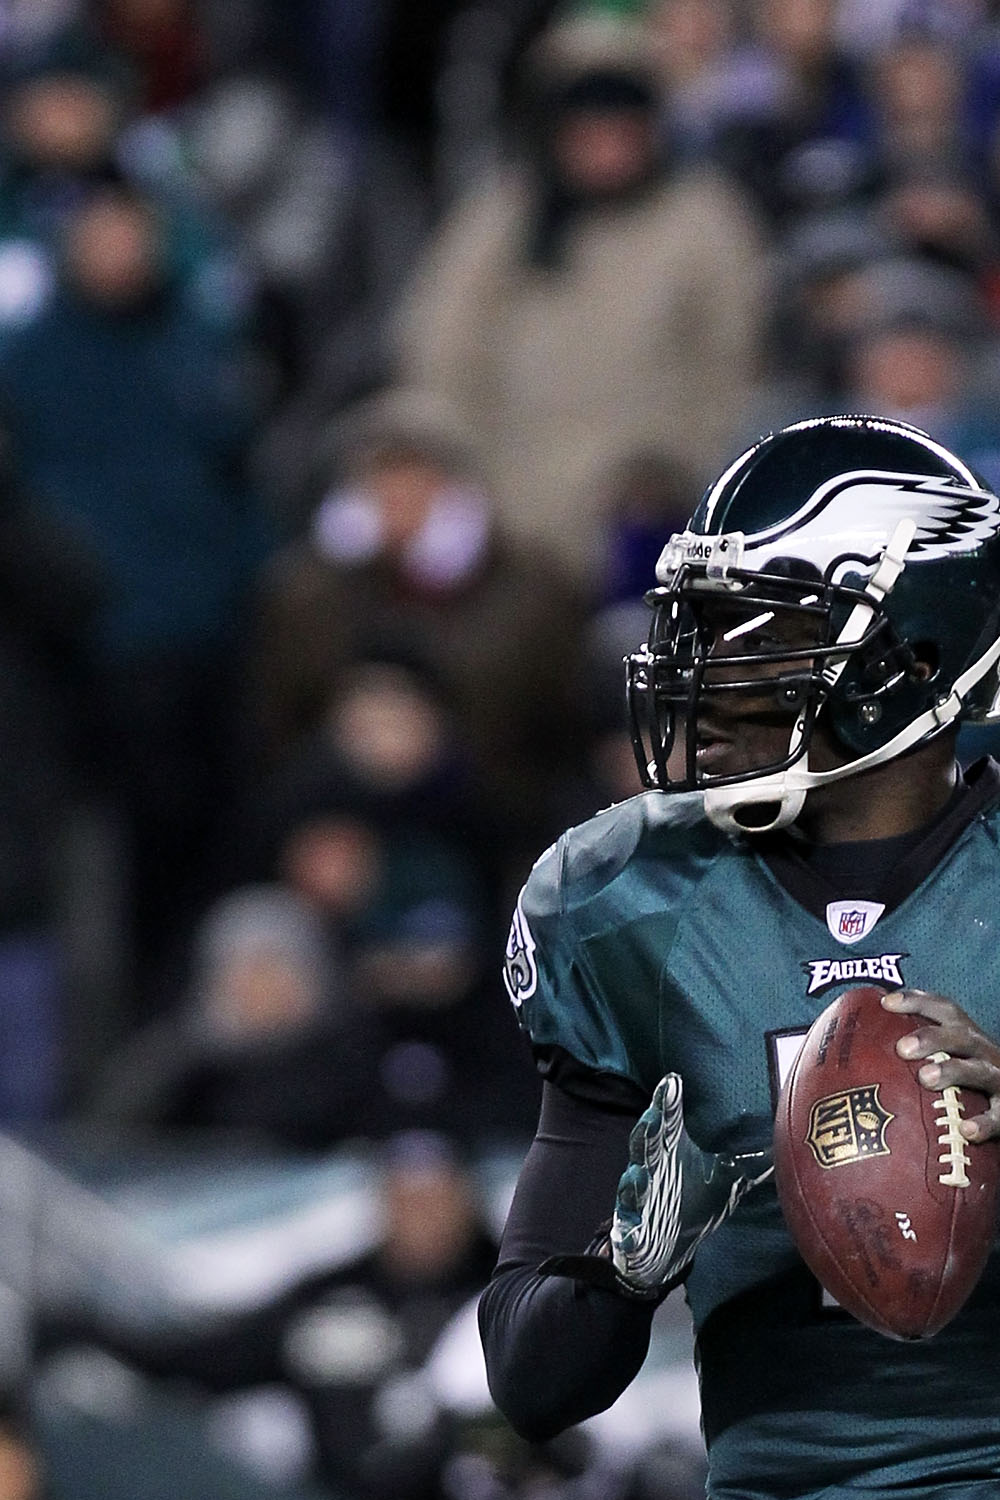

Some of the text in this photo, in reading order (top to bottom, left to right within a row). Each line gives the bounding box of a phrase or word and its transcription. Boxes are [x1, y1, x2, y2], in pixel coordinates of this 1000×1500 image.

[842, 919, 862, 933] NFL
[808, 954, 904, 994] EAGLES
[816, 1099, 852, 1160] NFL
